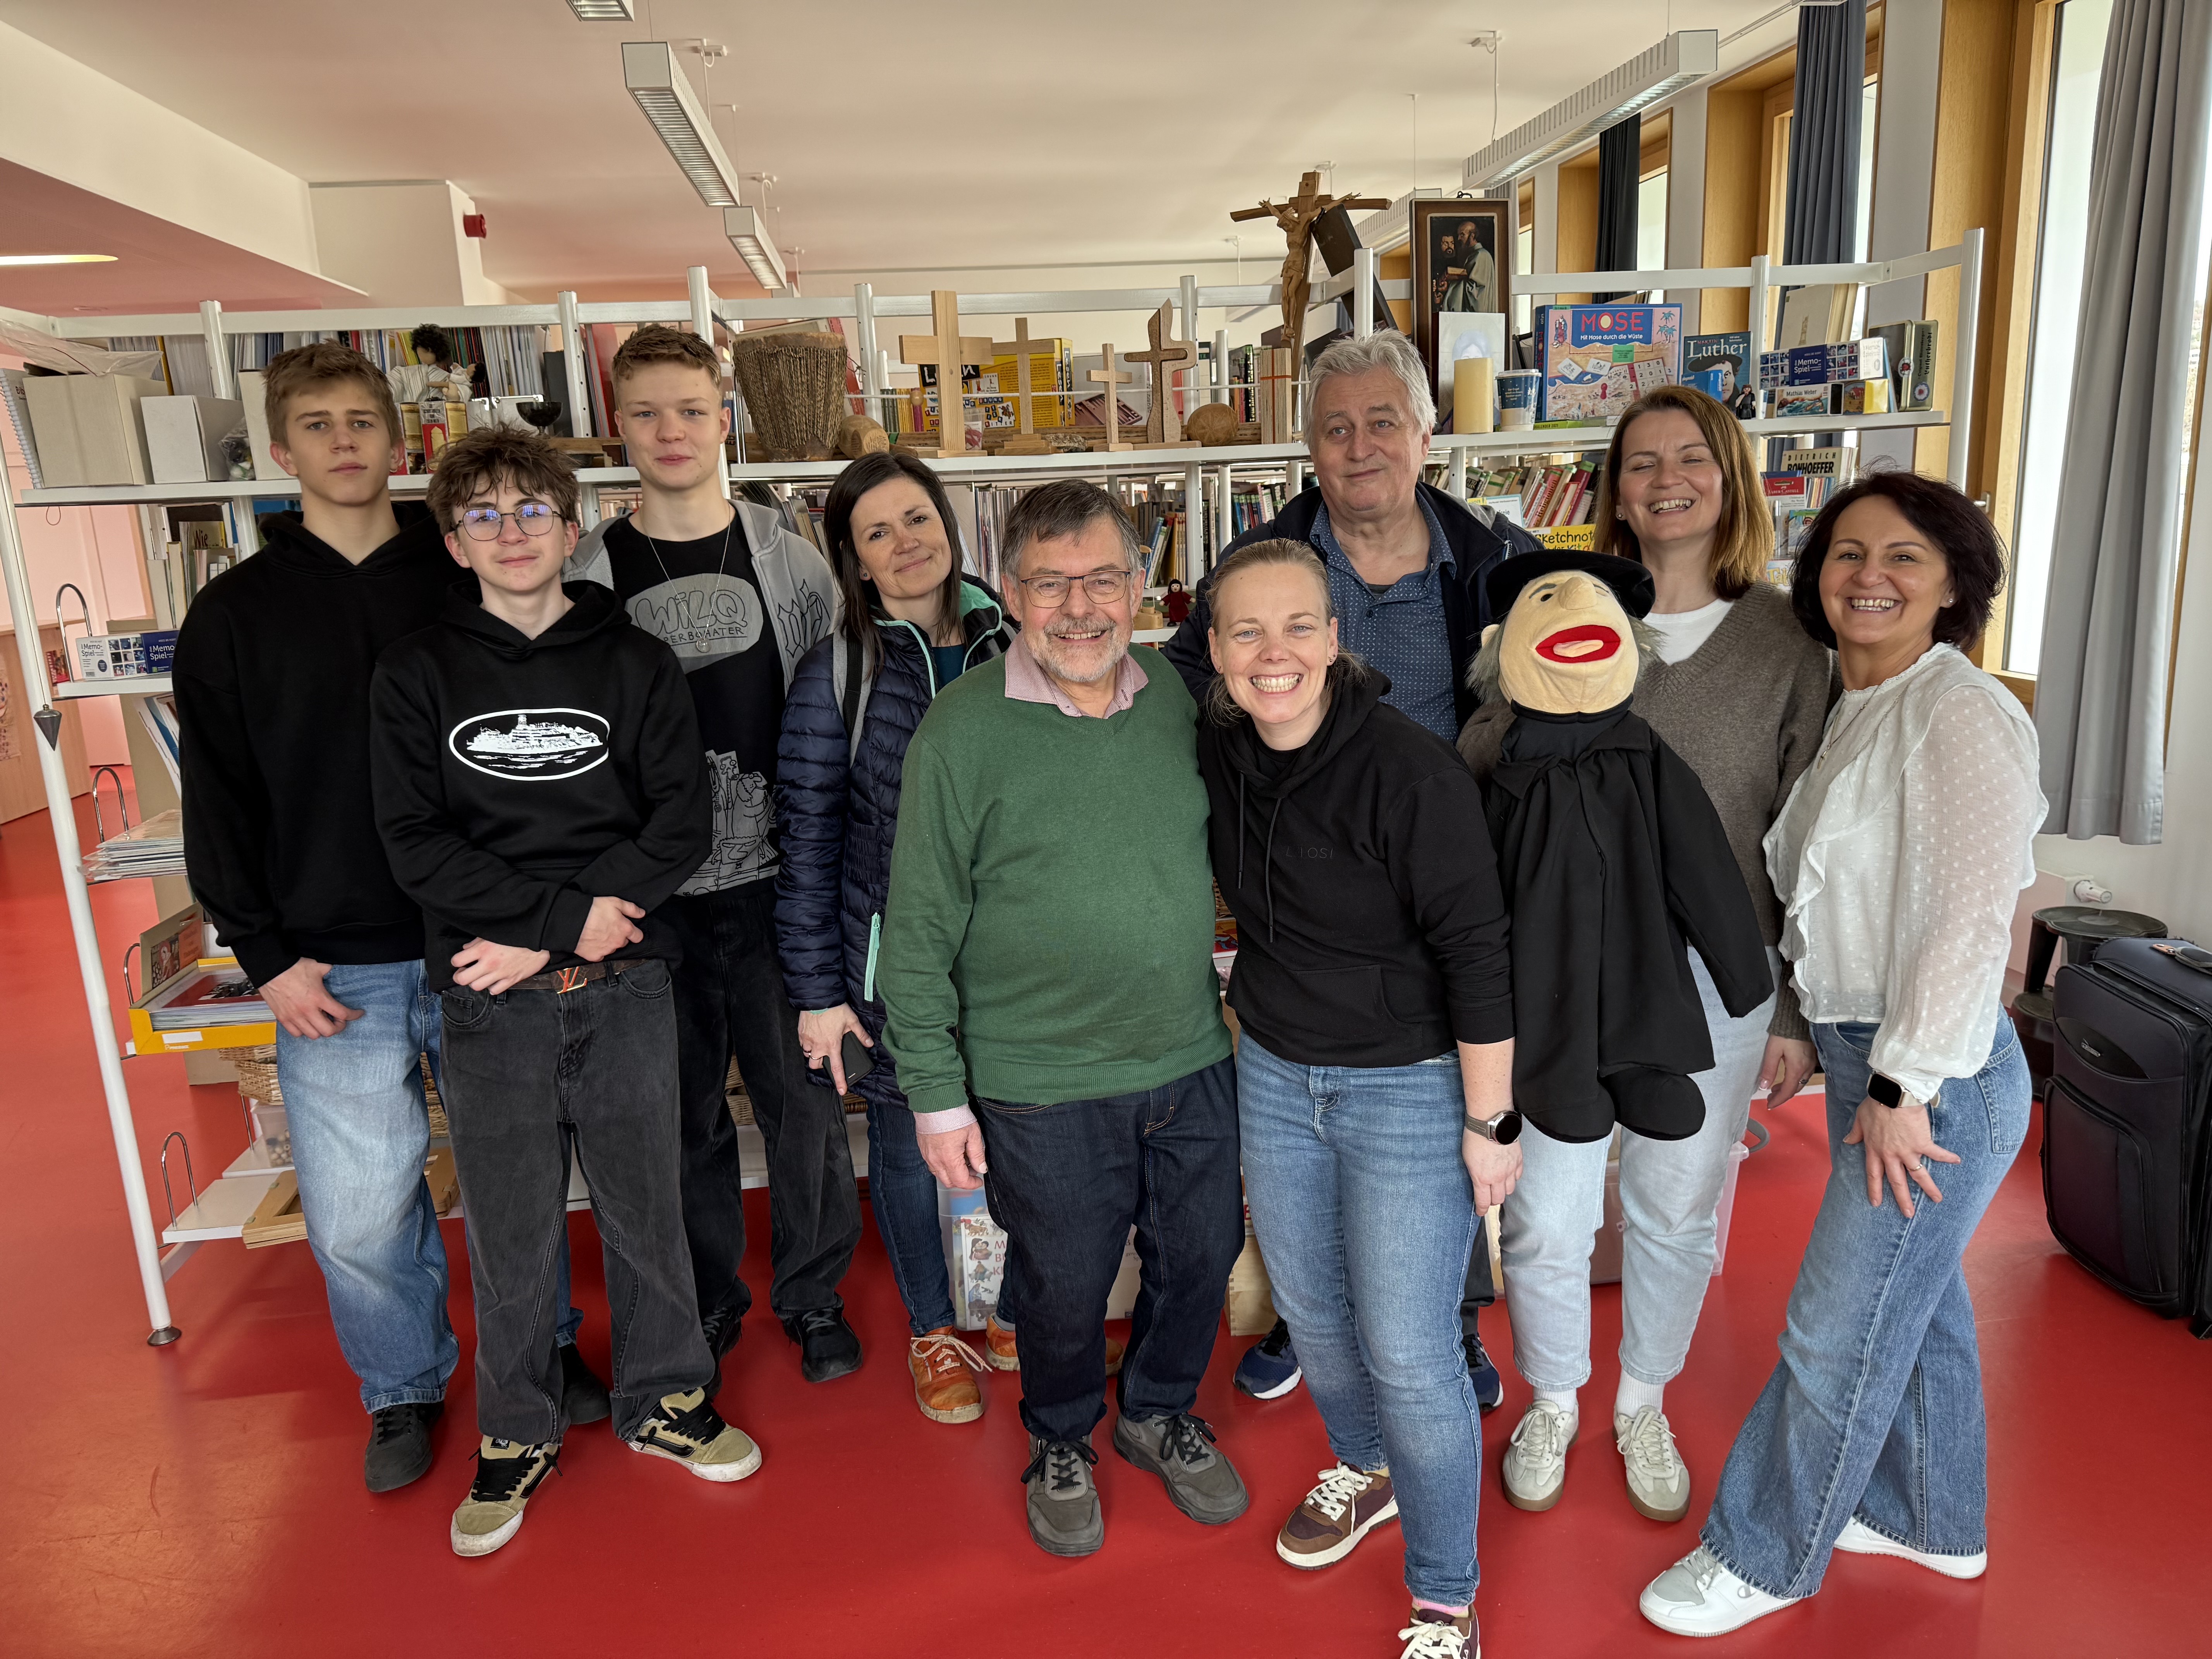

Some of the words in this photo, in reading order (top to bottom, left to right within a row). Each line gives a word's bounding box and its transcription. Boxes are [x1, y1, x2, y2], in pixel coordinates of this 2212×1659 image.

[1581, 312, 1644, 332] MOSE
[1687, 339, 1747, 360] Luther
[1794, 365, 1810, 374] Spiel
[1788, 452, 1836, 461] DIETRICH
[1787, 461, 1834, 474] BONHOEFFER
[150, 652, 167, 661] Spiel
